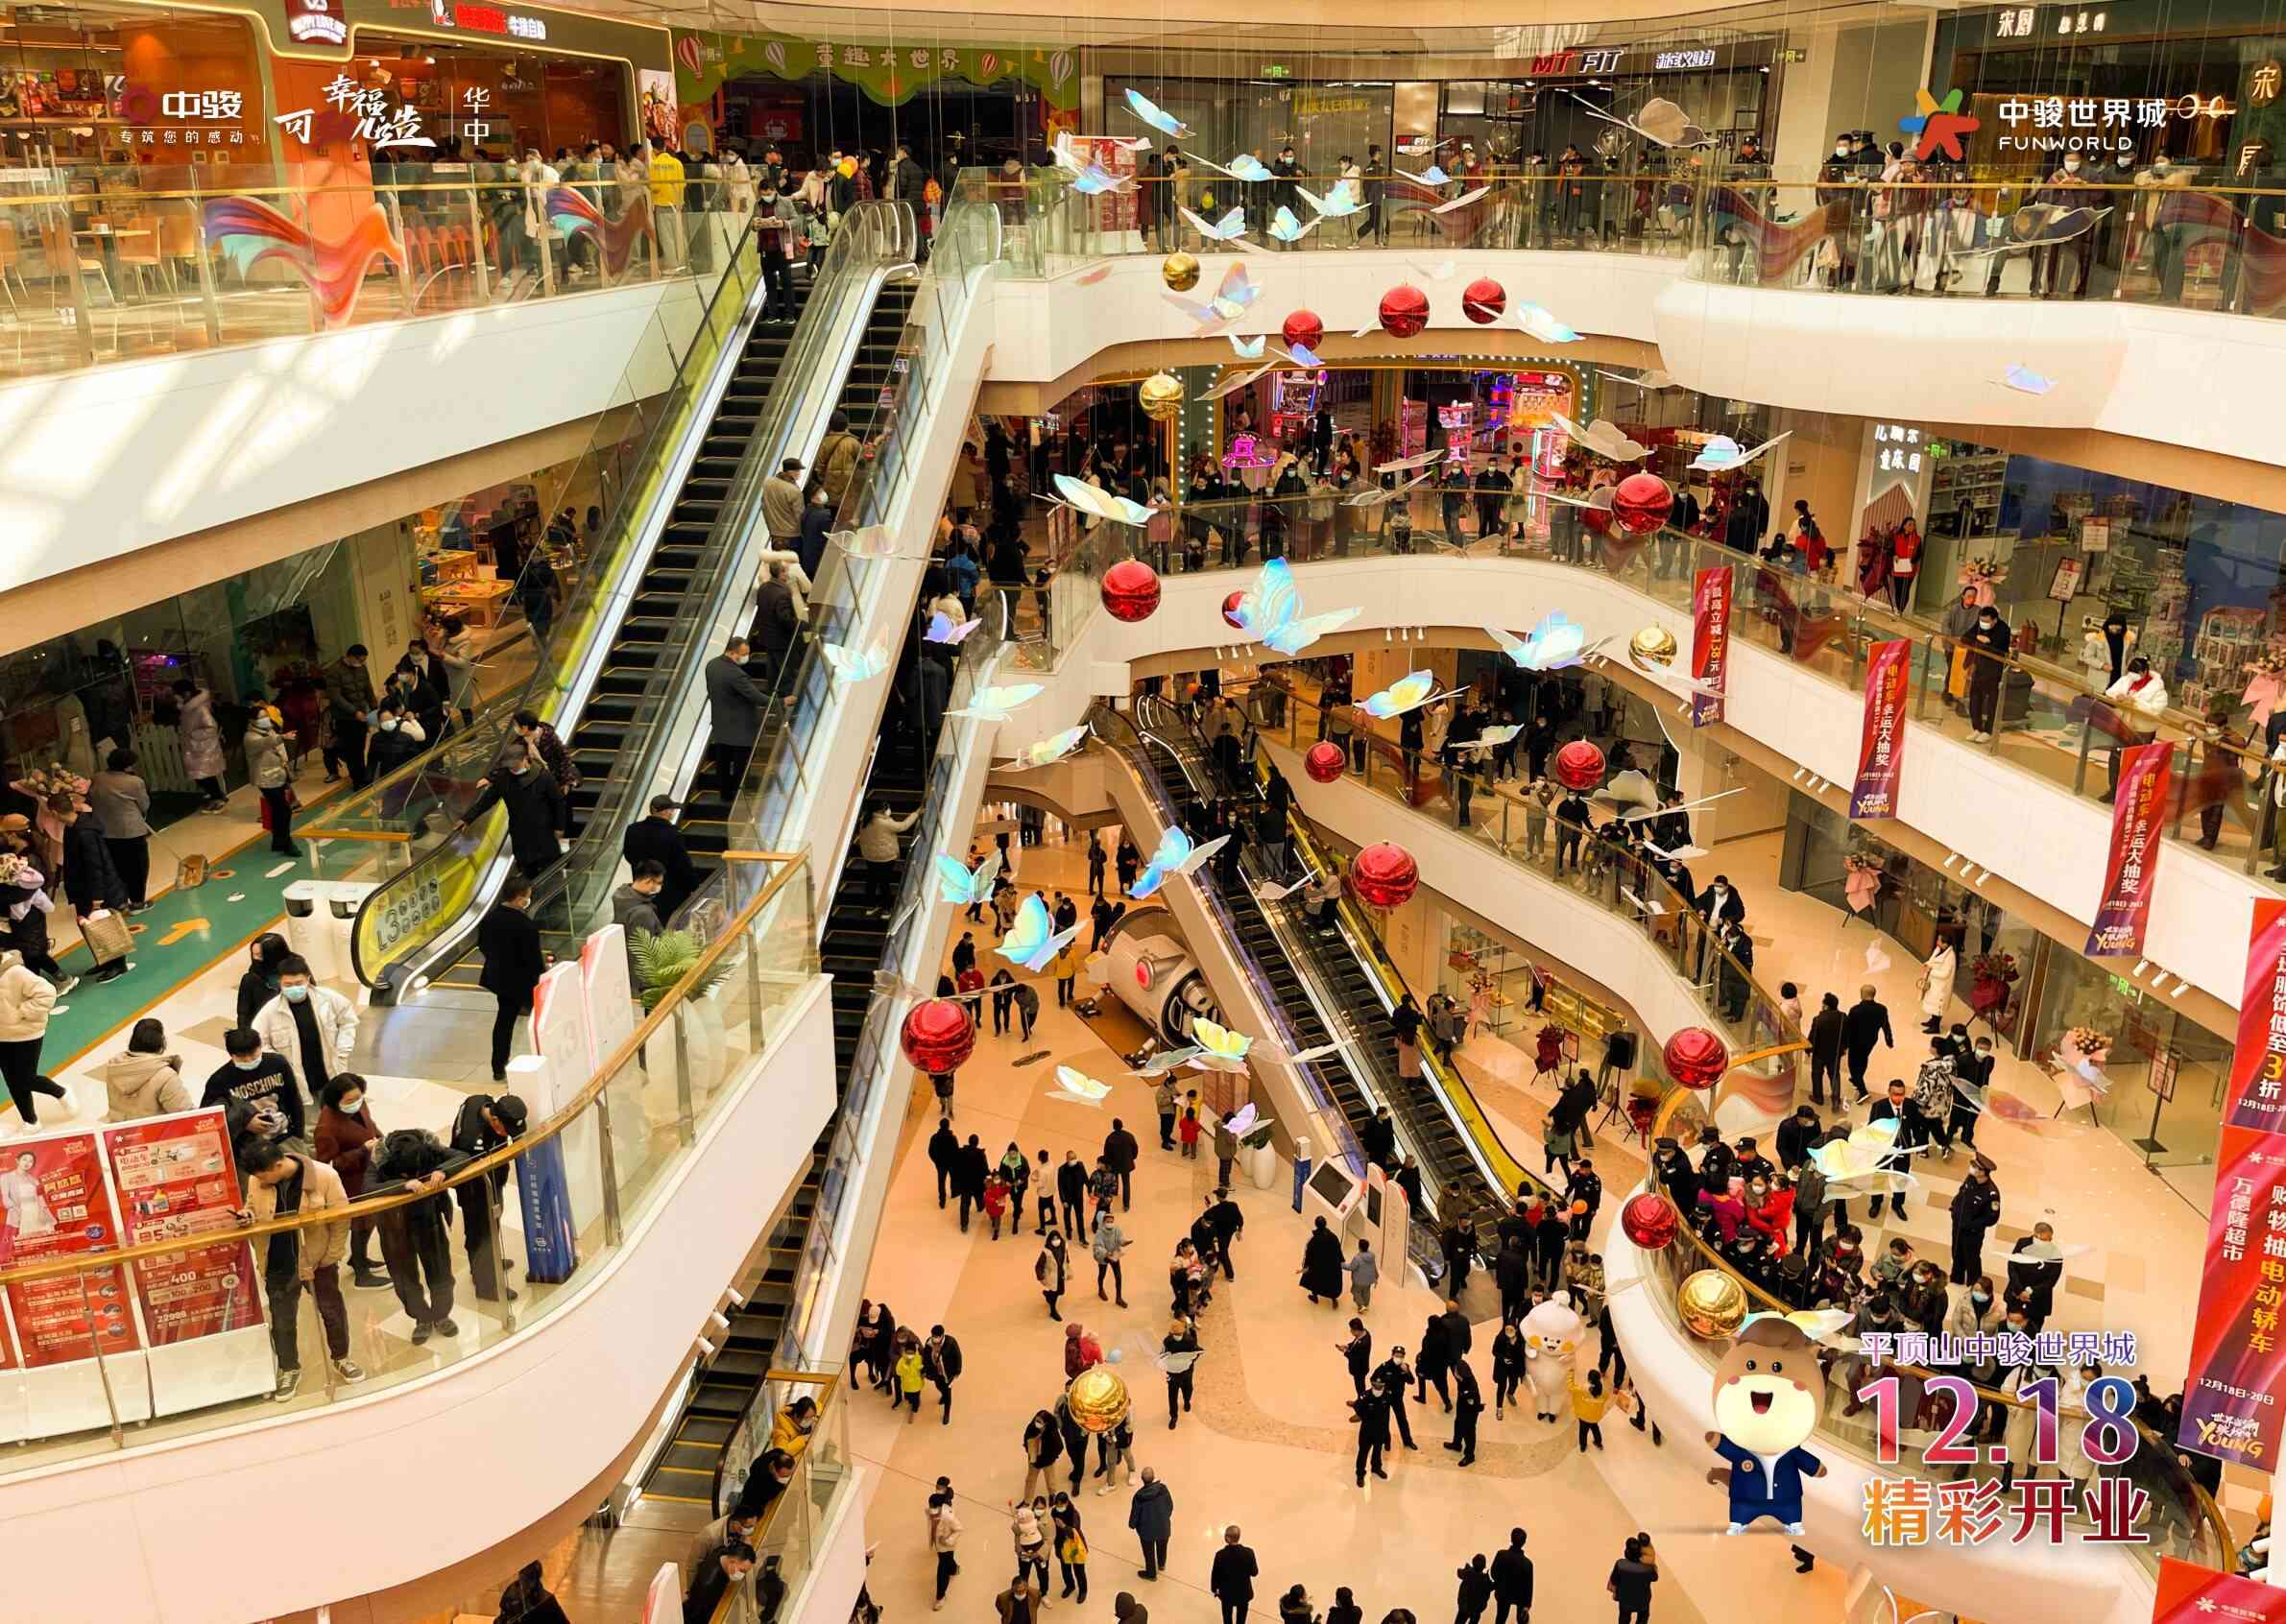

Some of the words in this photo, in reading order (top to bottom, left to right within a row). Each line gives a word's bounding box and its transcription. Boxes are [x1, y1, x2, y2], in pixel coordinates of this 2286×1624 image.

[1530, 51, 1575, 76] MT
[1577, 49, 1624, 73] FIT
[229, 1072, 285, 1100] MOSCHINO
[2223, 1176, 2253, 1263] 万德隆超市
[171, 1271, 197, 1284] 400
[2249, 1184, 2286, 1354] 购物抽电动轿车
[2198, 1377, 2274, 1406] 12月18日-20日
[2196, 1418, 2265, 1460] YOUNG
